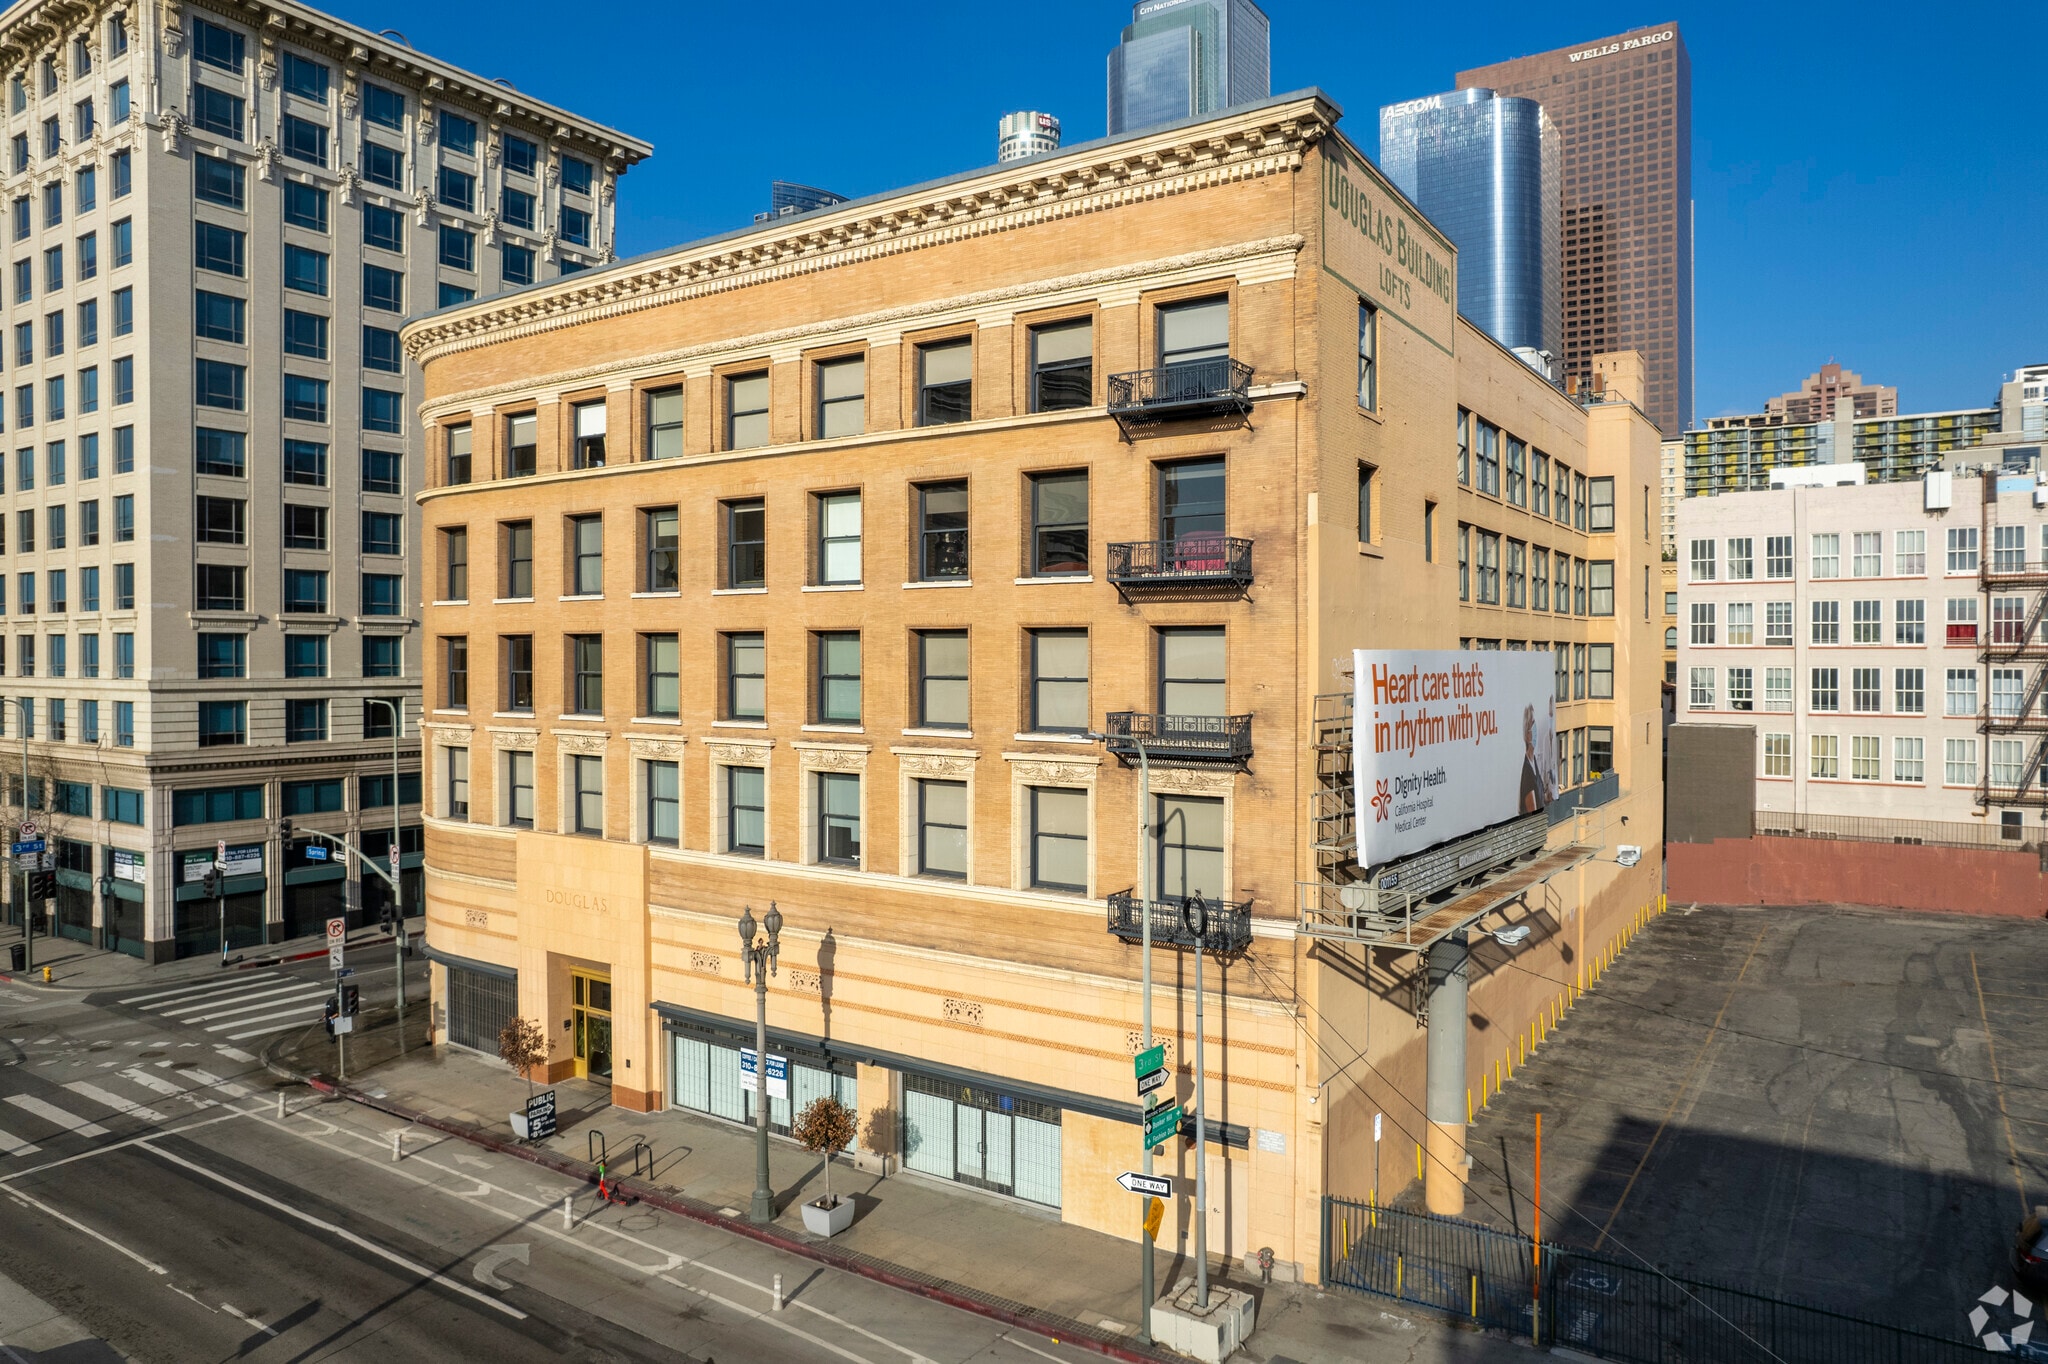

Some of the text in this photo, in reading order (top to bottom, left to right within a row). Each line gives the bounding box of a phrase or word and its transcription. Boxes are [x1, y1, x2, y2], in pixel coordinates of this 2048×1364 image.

[1568, 30, 1674, 63] WELLS FARGO
[1382, 95, 1442, 121] AECOM
[1329, 153, 1450, 305] DOUGLAS BUILDING
[1379, 262, 1411, 310] LOFTS
[1372, 663, 1419, 705] Heart
[1422, 672, 1449, 701] care
[1452, 662, 1484, 699] that's
[1375, 703, 1498, 758] in rhythm with you.
[1395, 766, 1446, 799] Dignity Health
[1395, 796, 1434, 817] California Hospital
[1395, 816, 1427, 834] Medical Center
[308, 849, 325, 858] Spring
[546, 889, 607, 912] DOUGLAS
[1138, 1053, 1161, 1070] 3rd St
[1141, 1074, 1161, 1089] ONE WAY
[528, 1091, 554, 1109] PUBLIC
[531, 1105, 552, 1117] PARKING
[1131, 1178, 1165, 1192] ONE WAY
